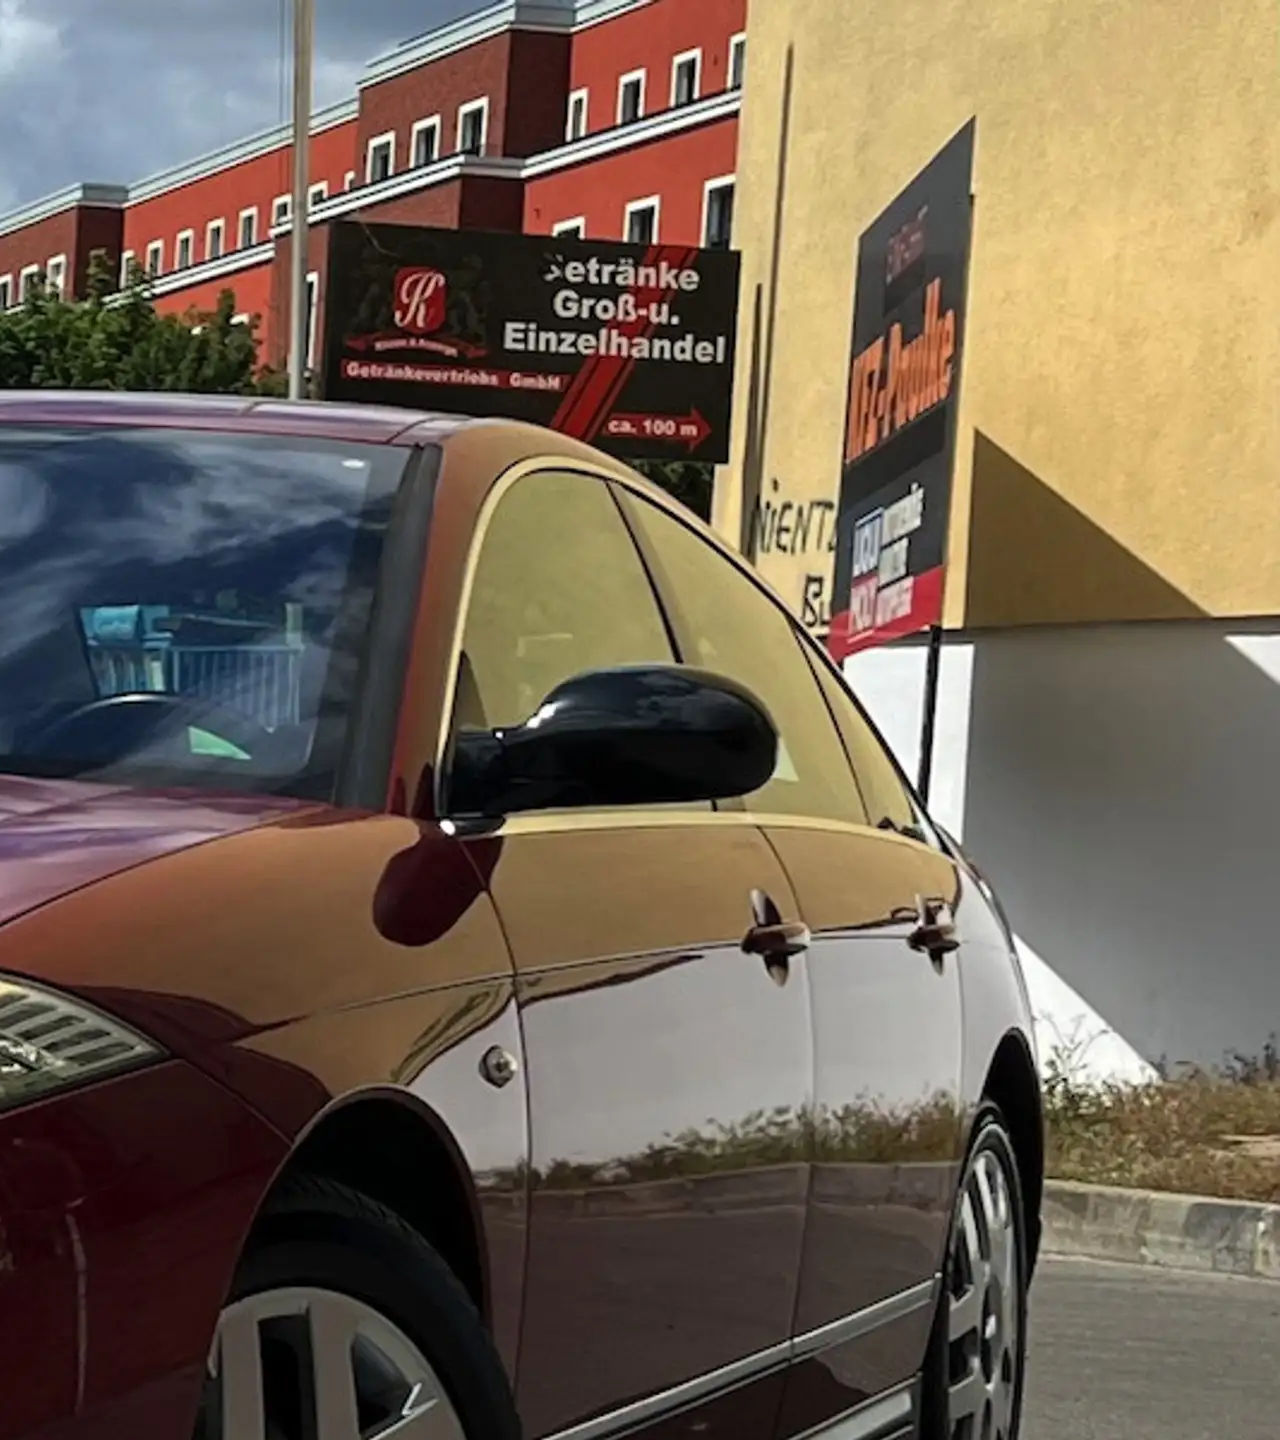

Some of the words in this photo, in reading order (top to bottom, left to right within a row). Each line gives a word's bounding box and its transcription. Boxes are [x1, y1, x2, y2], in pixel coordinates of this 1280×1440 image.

[503, 321, 726, 365] Einzelhandel
[346, 362, 499, 388] Getränkevertriebs
[509, 372, 561, 392] GmbH
[608, 417, 637, 435] ca.
[642, 418, 676, 436] 100
[680, 423, 698, 437] m
